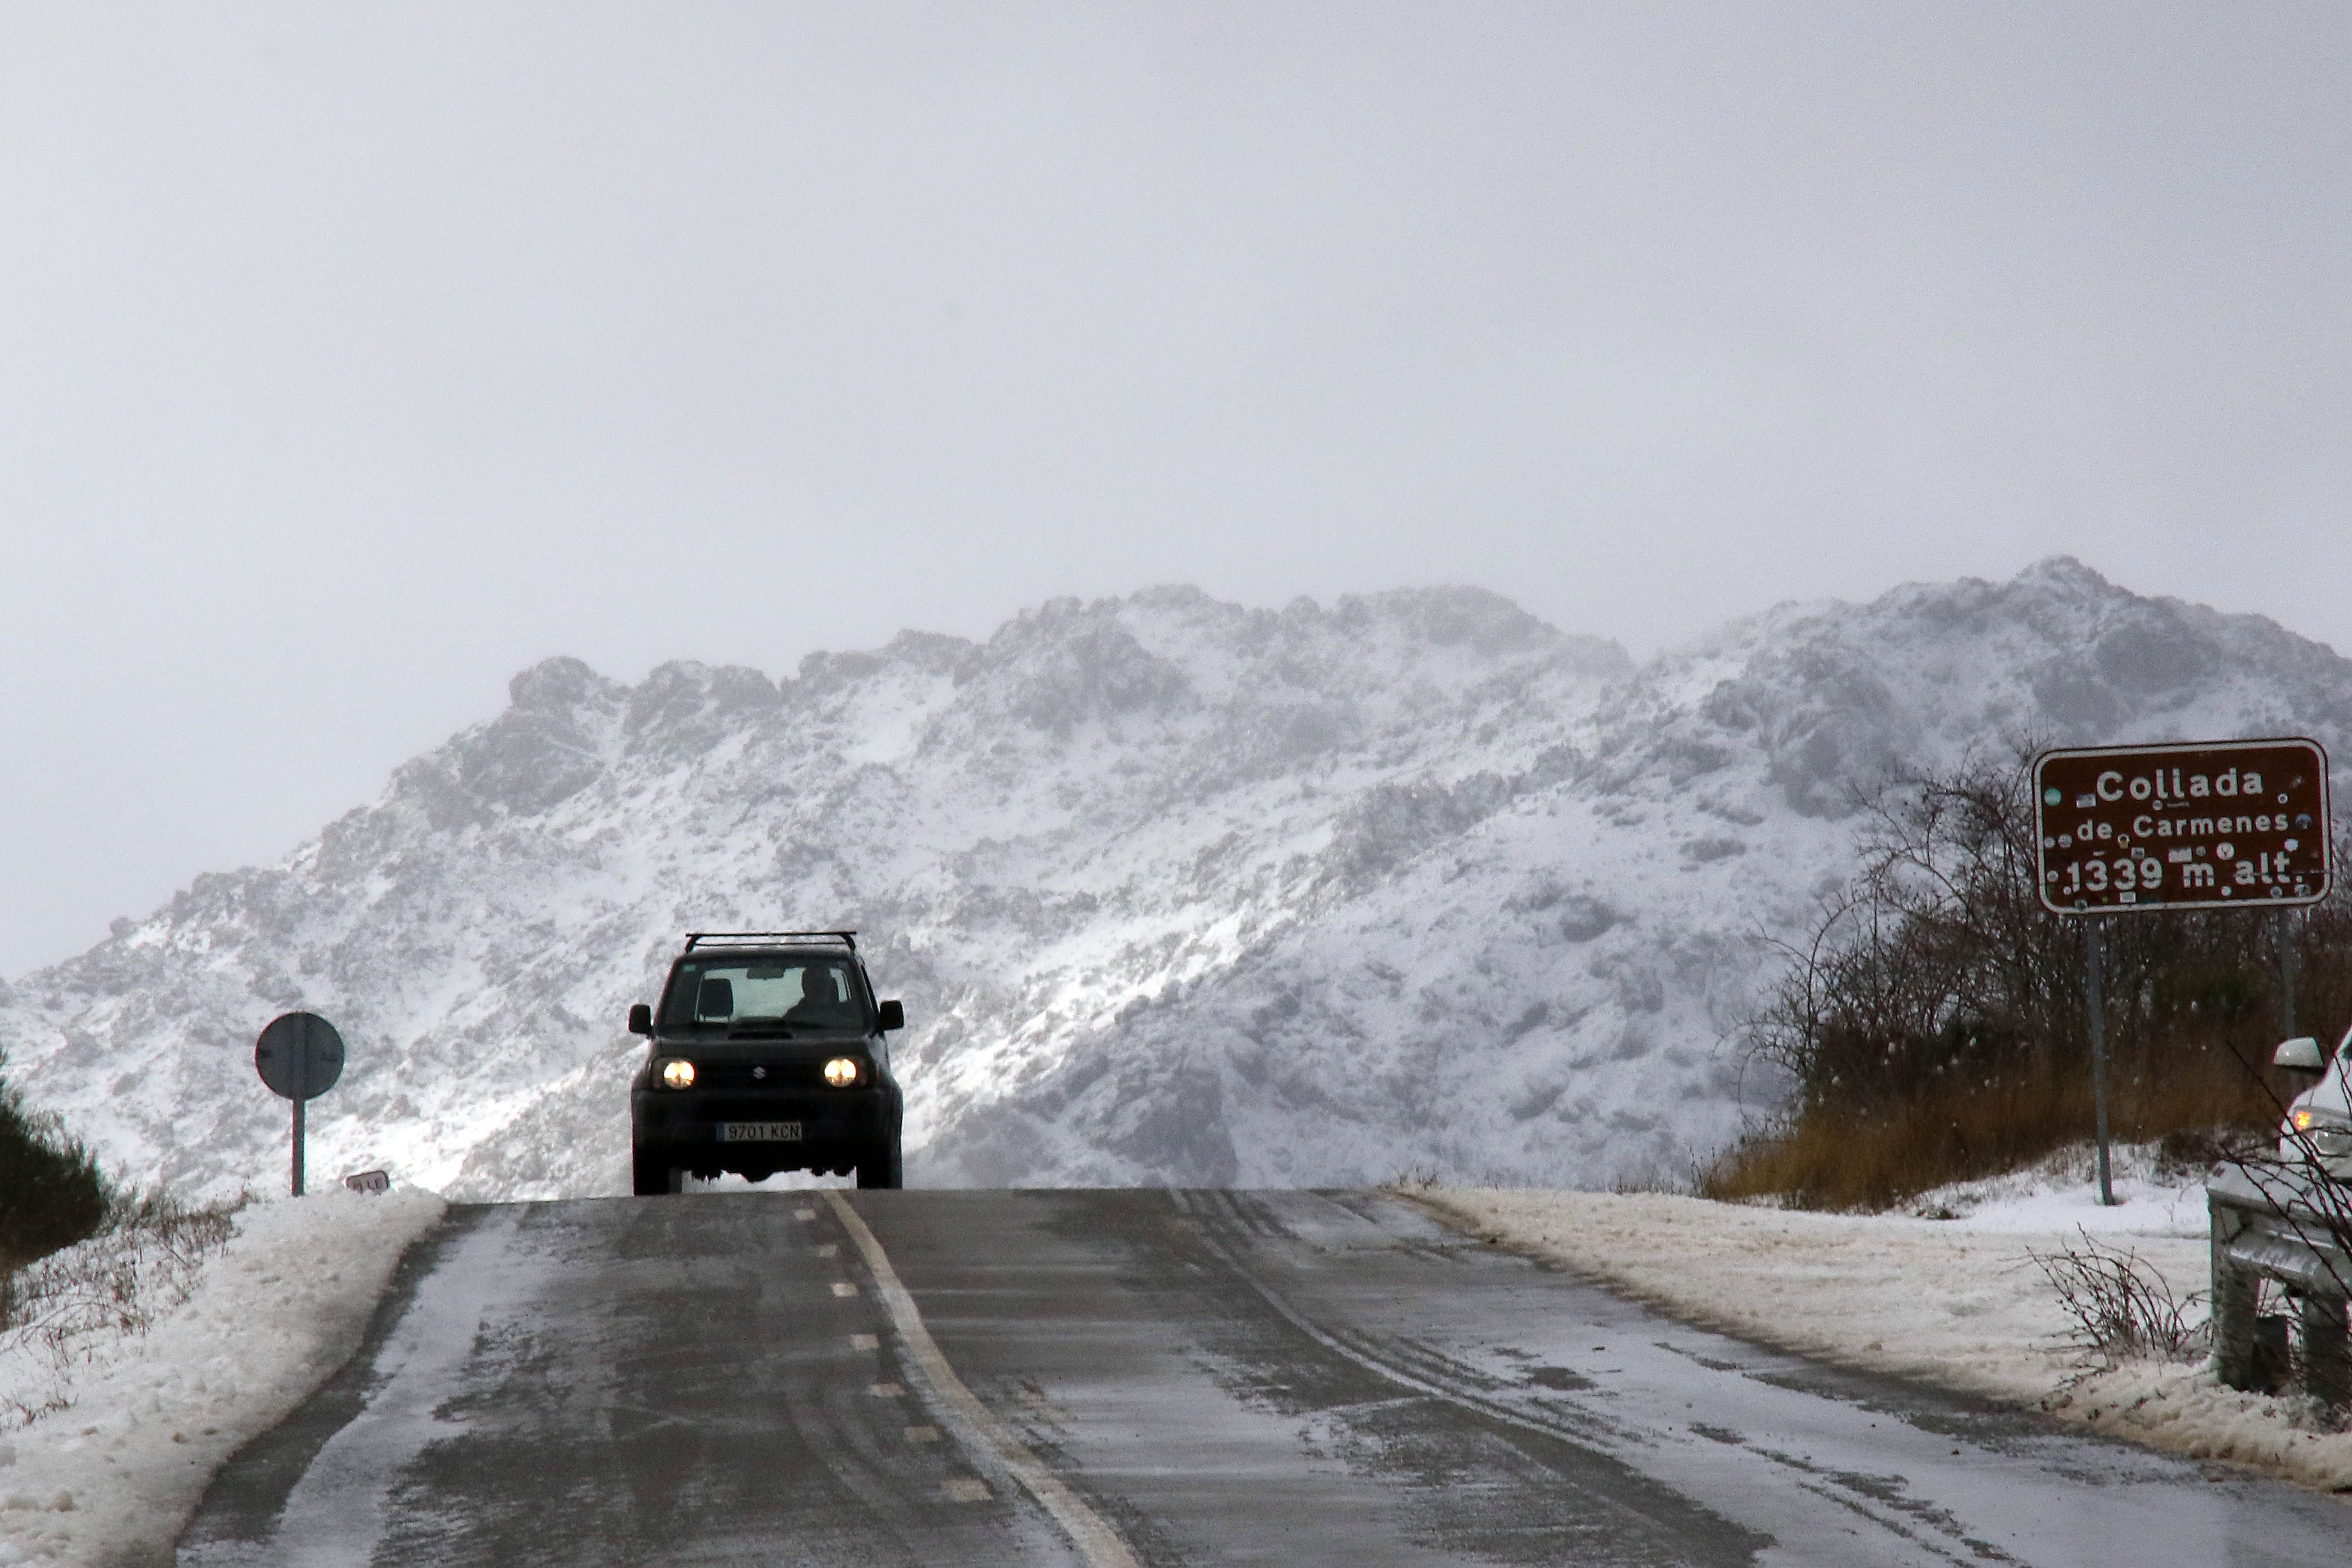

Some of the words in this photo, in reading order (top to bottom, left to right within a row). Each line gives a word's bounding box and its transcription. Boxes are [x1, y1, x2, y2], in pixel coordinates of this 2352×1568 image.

[2096, 767, 2263, 801] Collada
[2077, 819, 2113, 841] de
[2133, 814, 2289, 837] Carmenes
[2067, 857, 2163, 892] 1339
[2182, 862, 2215, 888] m
[729, 1125, 763, 1138] 9701
[771, 1125, 799, 1139] KCN
